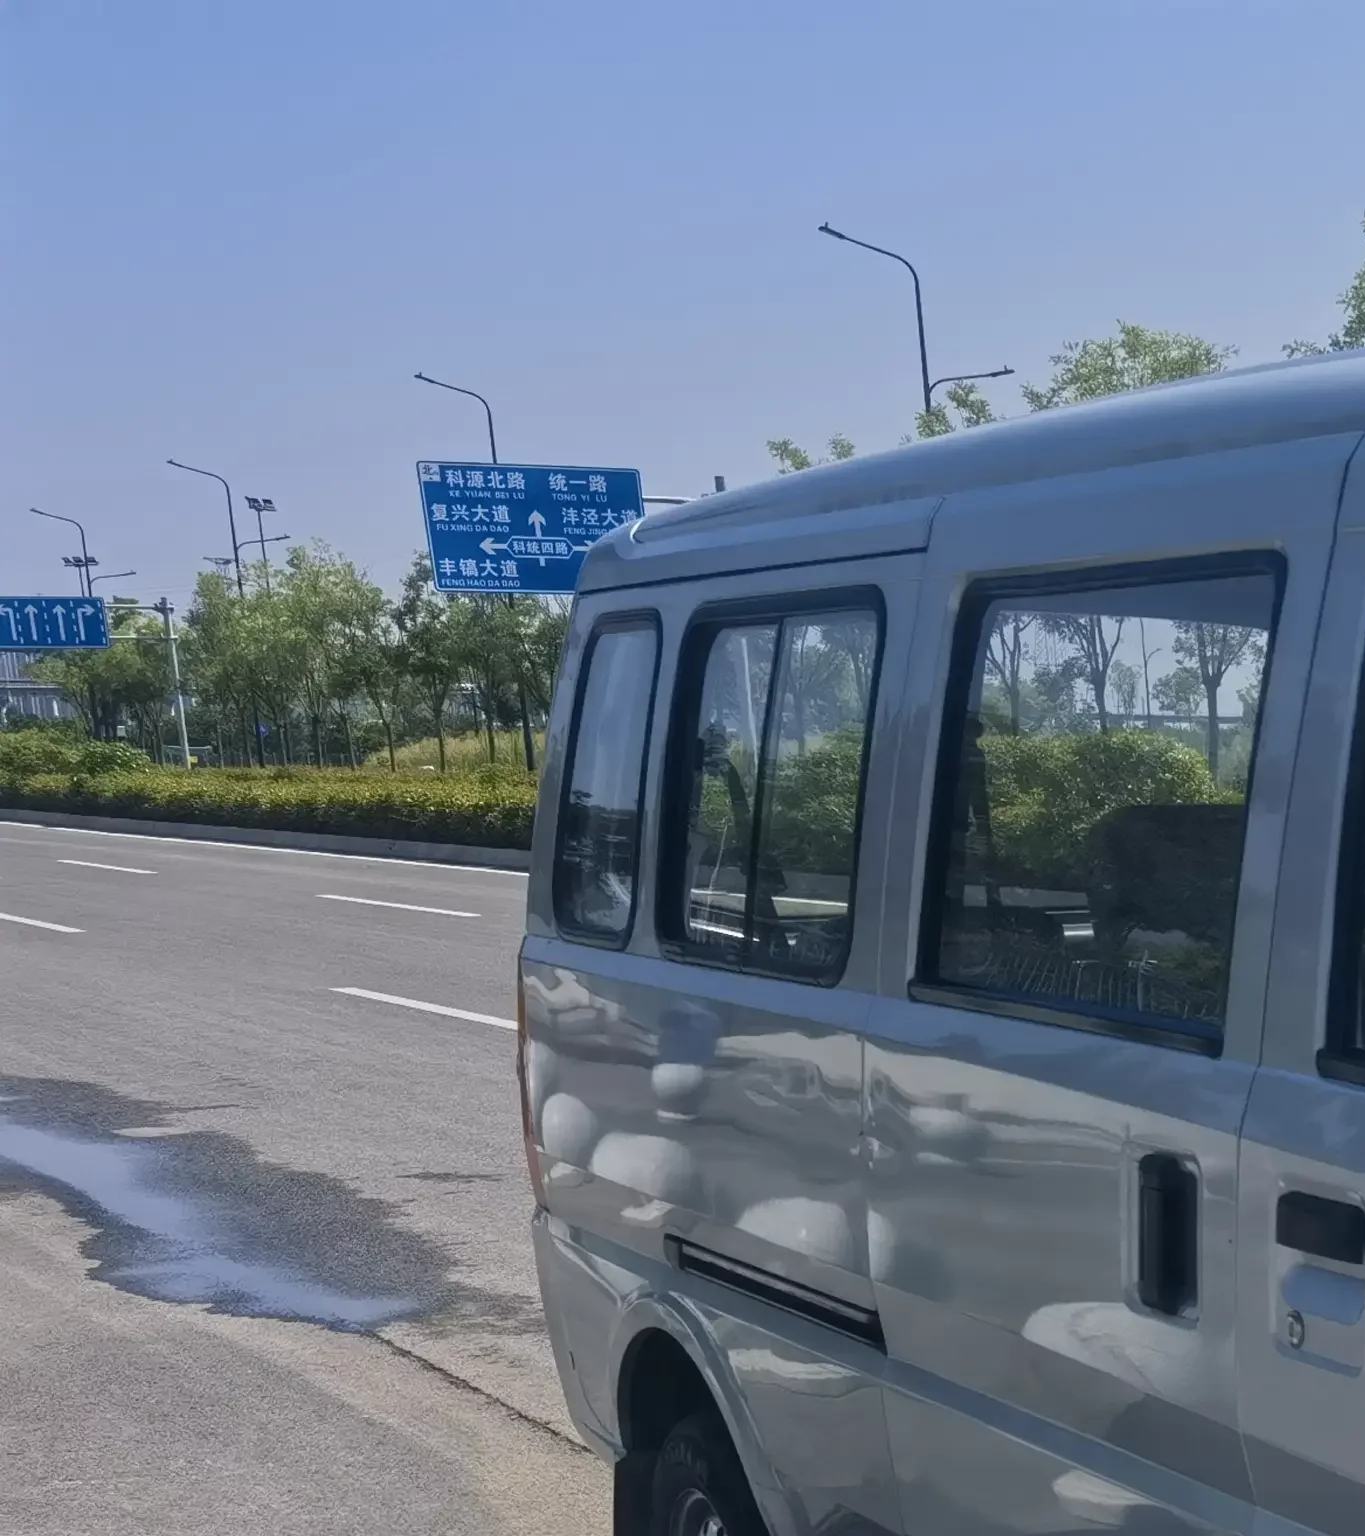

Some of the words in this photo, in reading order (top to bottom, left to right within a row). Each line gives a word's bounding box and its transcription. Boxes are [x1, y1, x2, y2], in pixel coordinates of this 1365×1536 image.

[445, 469, 525, 490] 科源北路
[548, 472, 607, 493] 统一路
[449, 490, 461, 498] KE
[464, 490, 491, 499] YUAN
[495, 491, 510, 500] BEI
[513, 492, 525, 500] LU
[552, 493, 577, 502] TONG
[580, 494, 590, 502] YI
[596, 494, 608, 502] LU
[431, 503, 511, 522] 复兴大道
[450, 524, 473, 532] XING
[490, 525, 509, 533] DAO
[563, 527, 586, 536] FENG
[588, 528, 608, 536] JING
[512, 540, 569, 555] 科统四路
[438, 557, 519, 578] 丰镐大道
[441, 578, 465, 587] FENG
[467, 579, 486, 587] HAO
[503, 579, 520, 588] DAO
